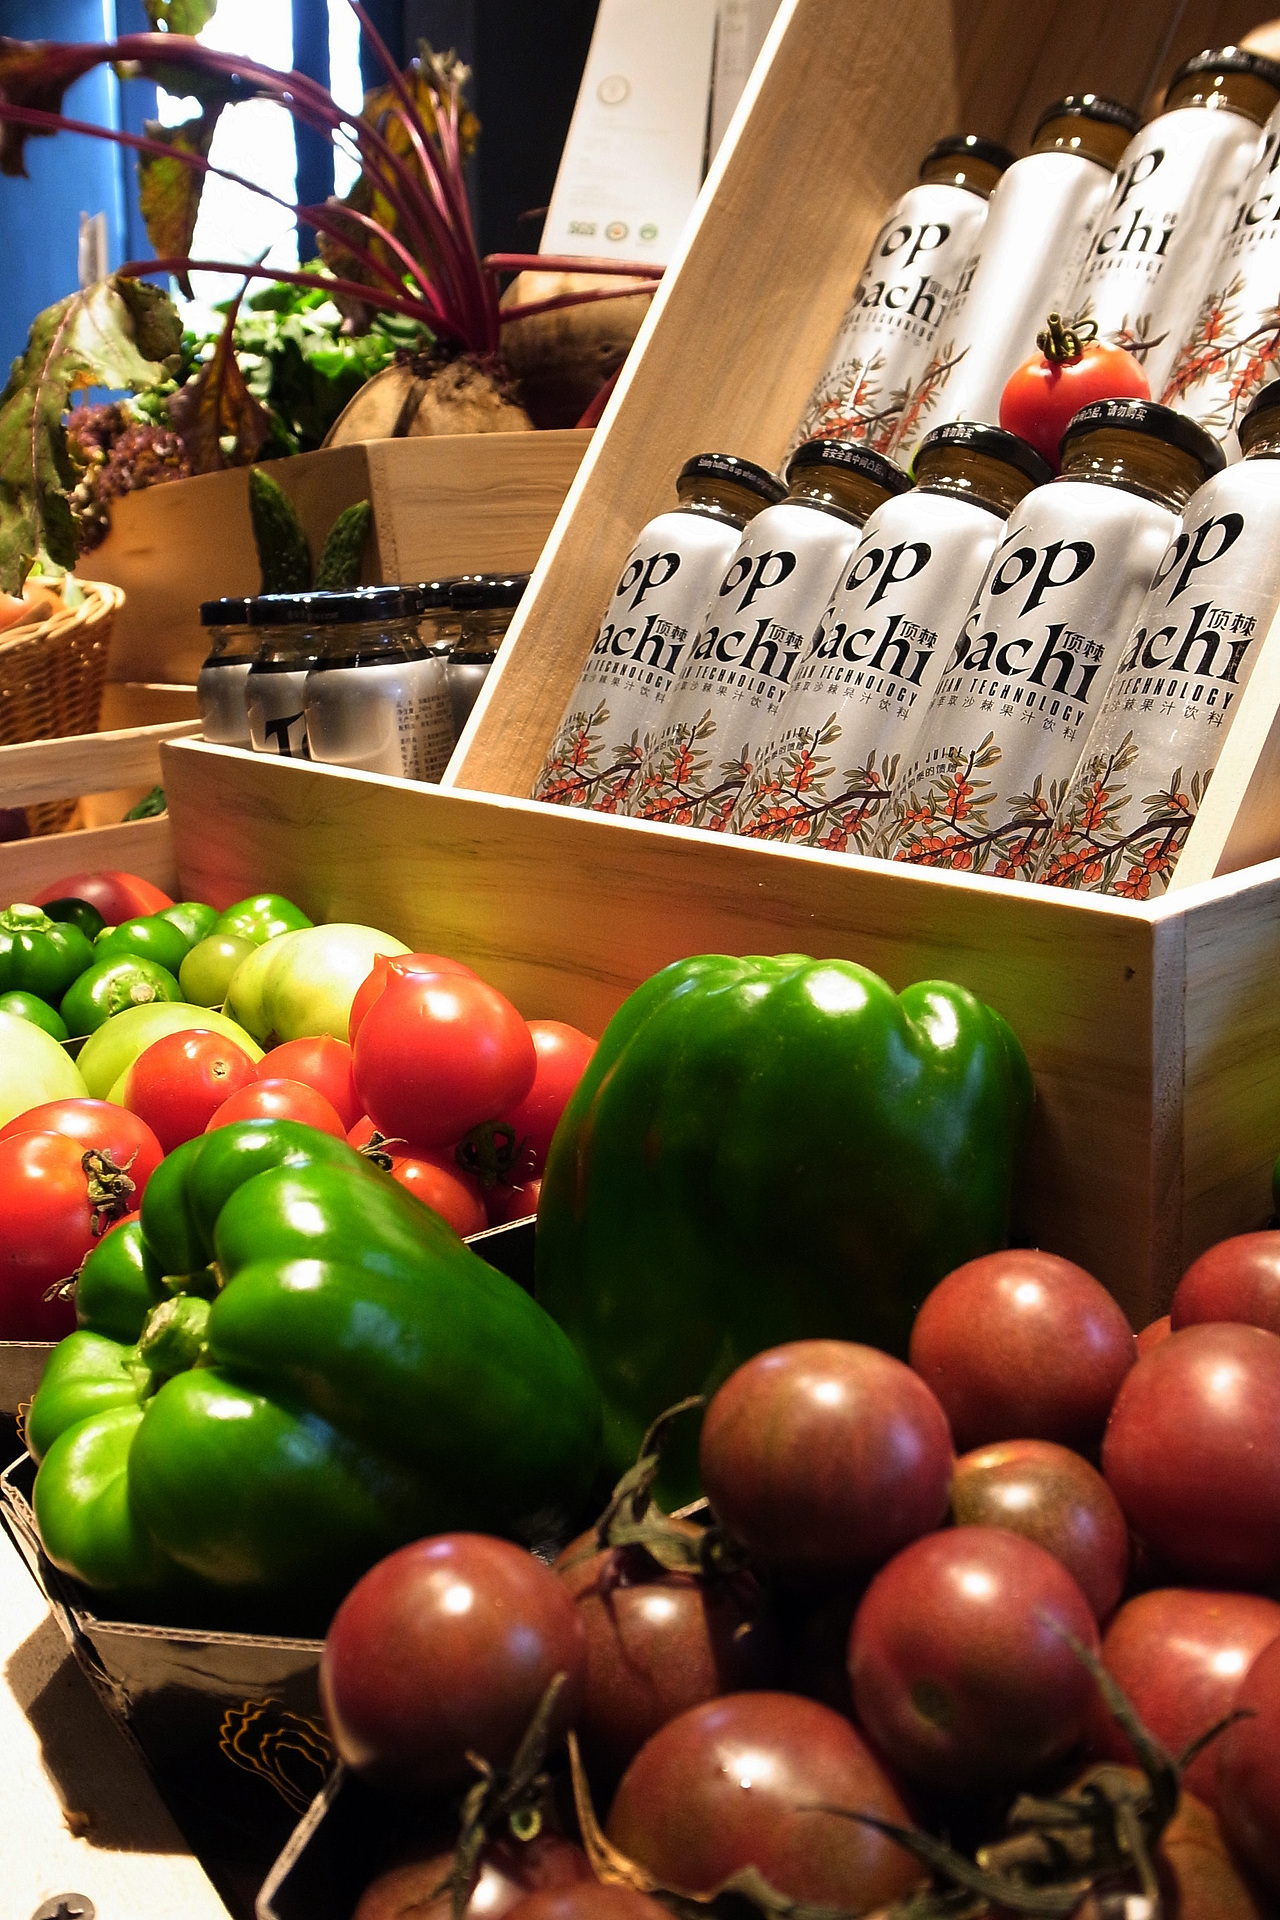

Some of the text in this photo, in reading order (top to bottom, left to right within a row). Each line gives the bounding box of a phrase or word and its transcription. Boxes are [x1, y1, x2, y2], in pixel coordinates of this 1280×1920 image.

[874, 213, 951, 268] op
[1087, 207, 1174, 261] chi
[616, 543, 681, 612] op
[719, 539, 797, 614] op
[593, 613, 685, 675] achi
[690, 614, 801, 684] achi
[594, 660, 672, 692] TECHNOLOGY
[696, 666, 786, 702] TECHNOLOGY
[820, 666, 917, 707] TECHNOLOGY
[1118, 678, 1234, 709] TECHNOLOGY
[970, 679, 1084, 726] TECHNOLOGY
[926, 746, 963, 763] JUICE
